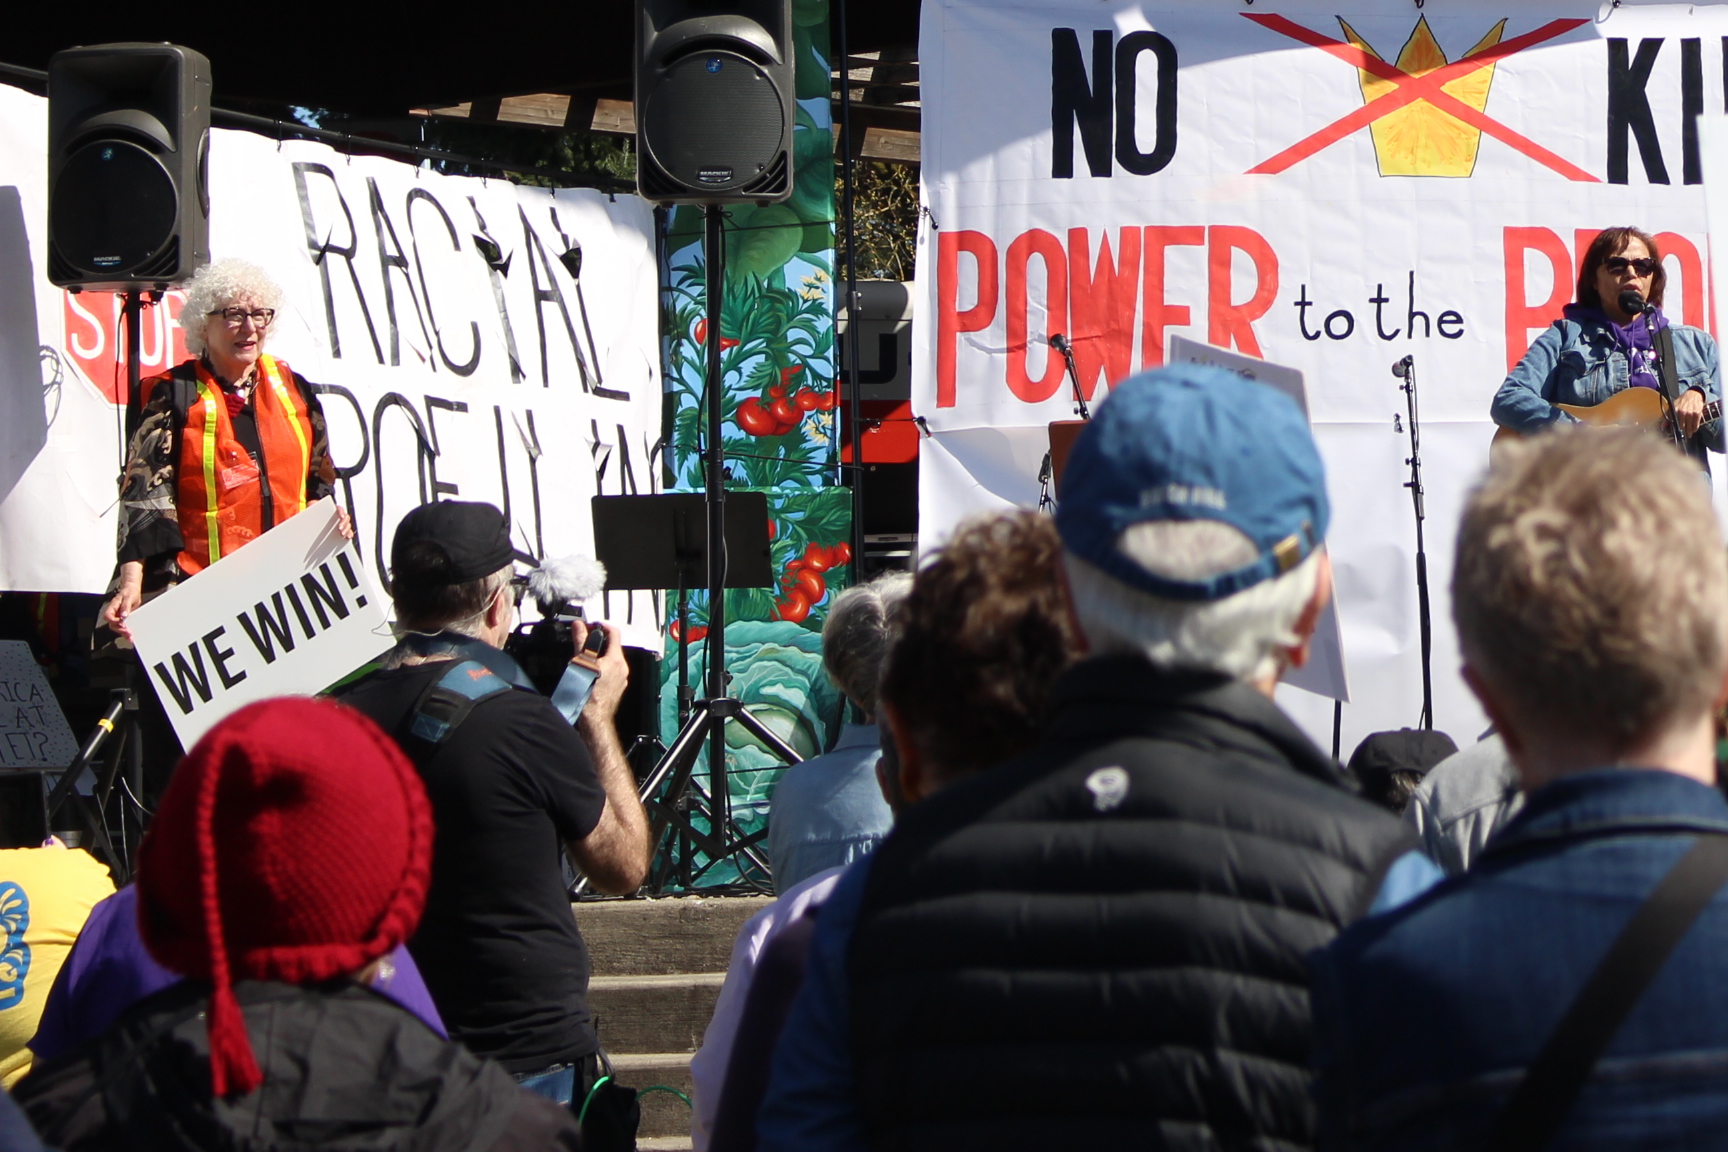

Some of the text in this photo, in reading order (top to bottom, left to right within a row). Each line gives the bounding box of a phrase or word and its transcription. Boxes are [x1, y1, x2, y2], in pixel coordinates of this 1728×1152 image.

[1052, 27, 1179, 180] NO
[292, 161, 630, 402] RACIAL
[936, 224, 1279, 409] POWER
[1295, 283, 1356, 341] to
[1377, 270, 1464, 341] the
[154, 553, 368, 715] WE WIN!
